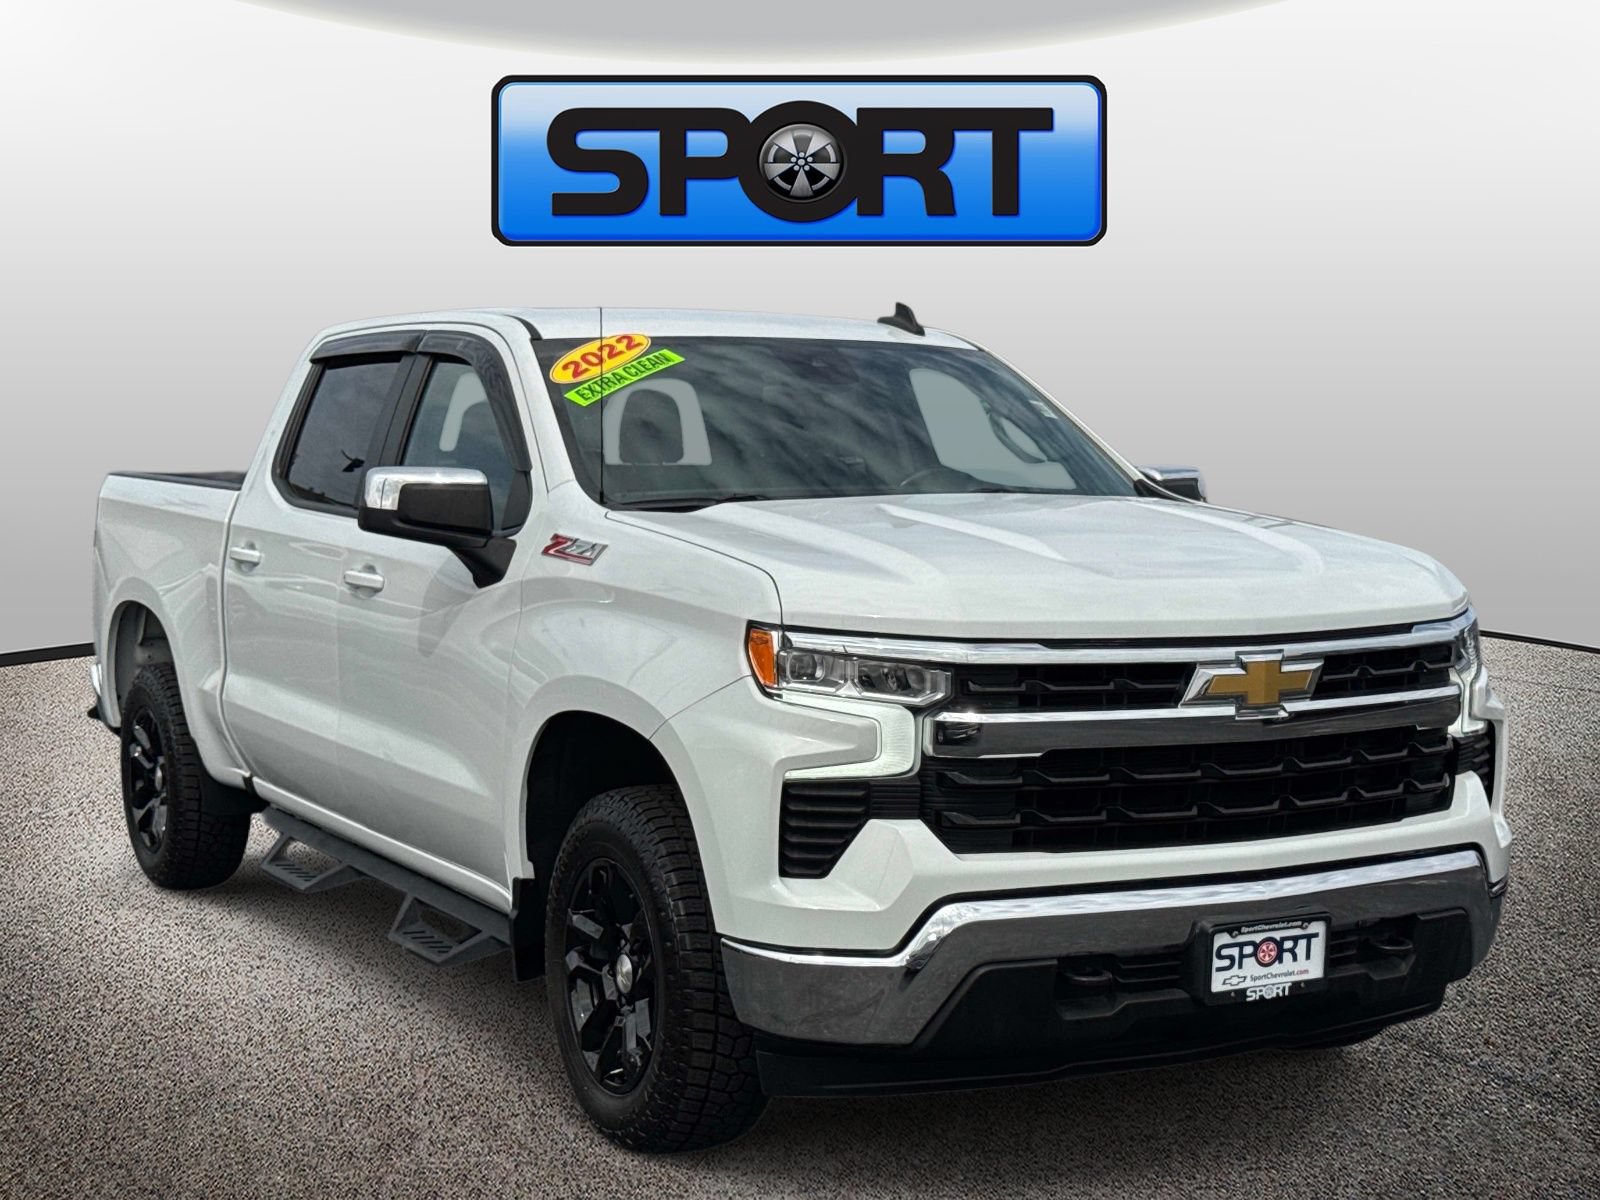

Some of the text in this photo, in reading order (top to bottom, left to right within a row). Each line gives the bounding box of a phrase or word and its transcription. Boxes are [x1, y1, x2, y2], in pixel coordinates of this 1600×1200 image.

[561, 335, 643, 379] 2022
[575, 352, 671, 401] EXTRA CLEAN
[1215, 932, 1319, 972] SPORT
[1246, 983, 1292, 1001] SPORT
[1249, 968, 1309, 983] SportChevrolet.com
